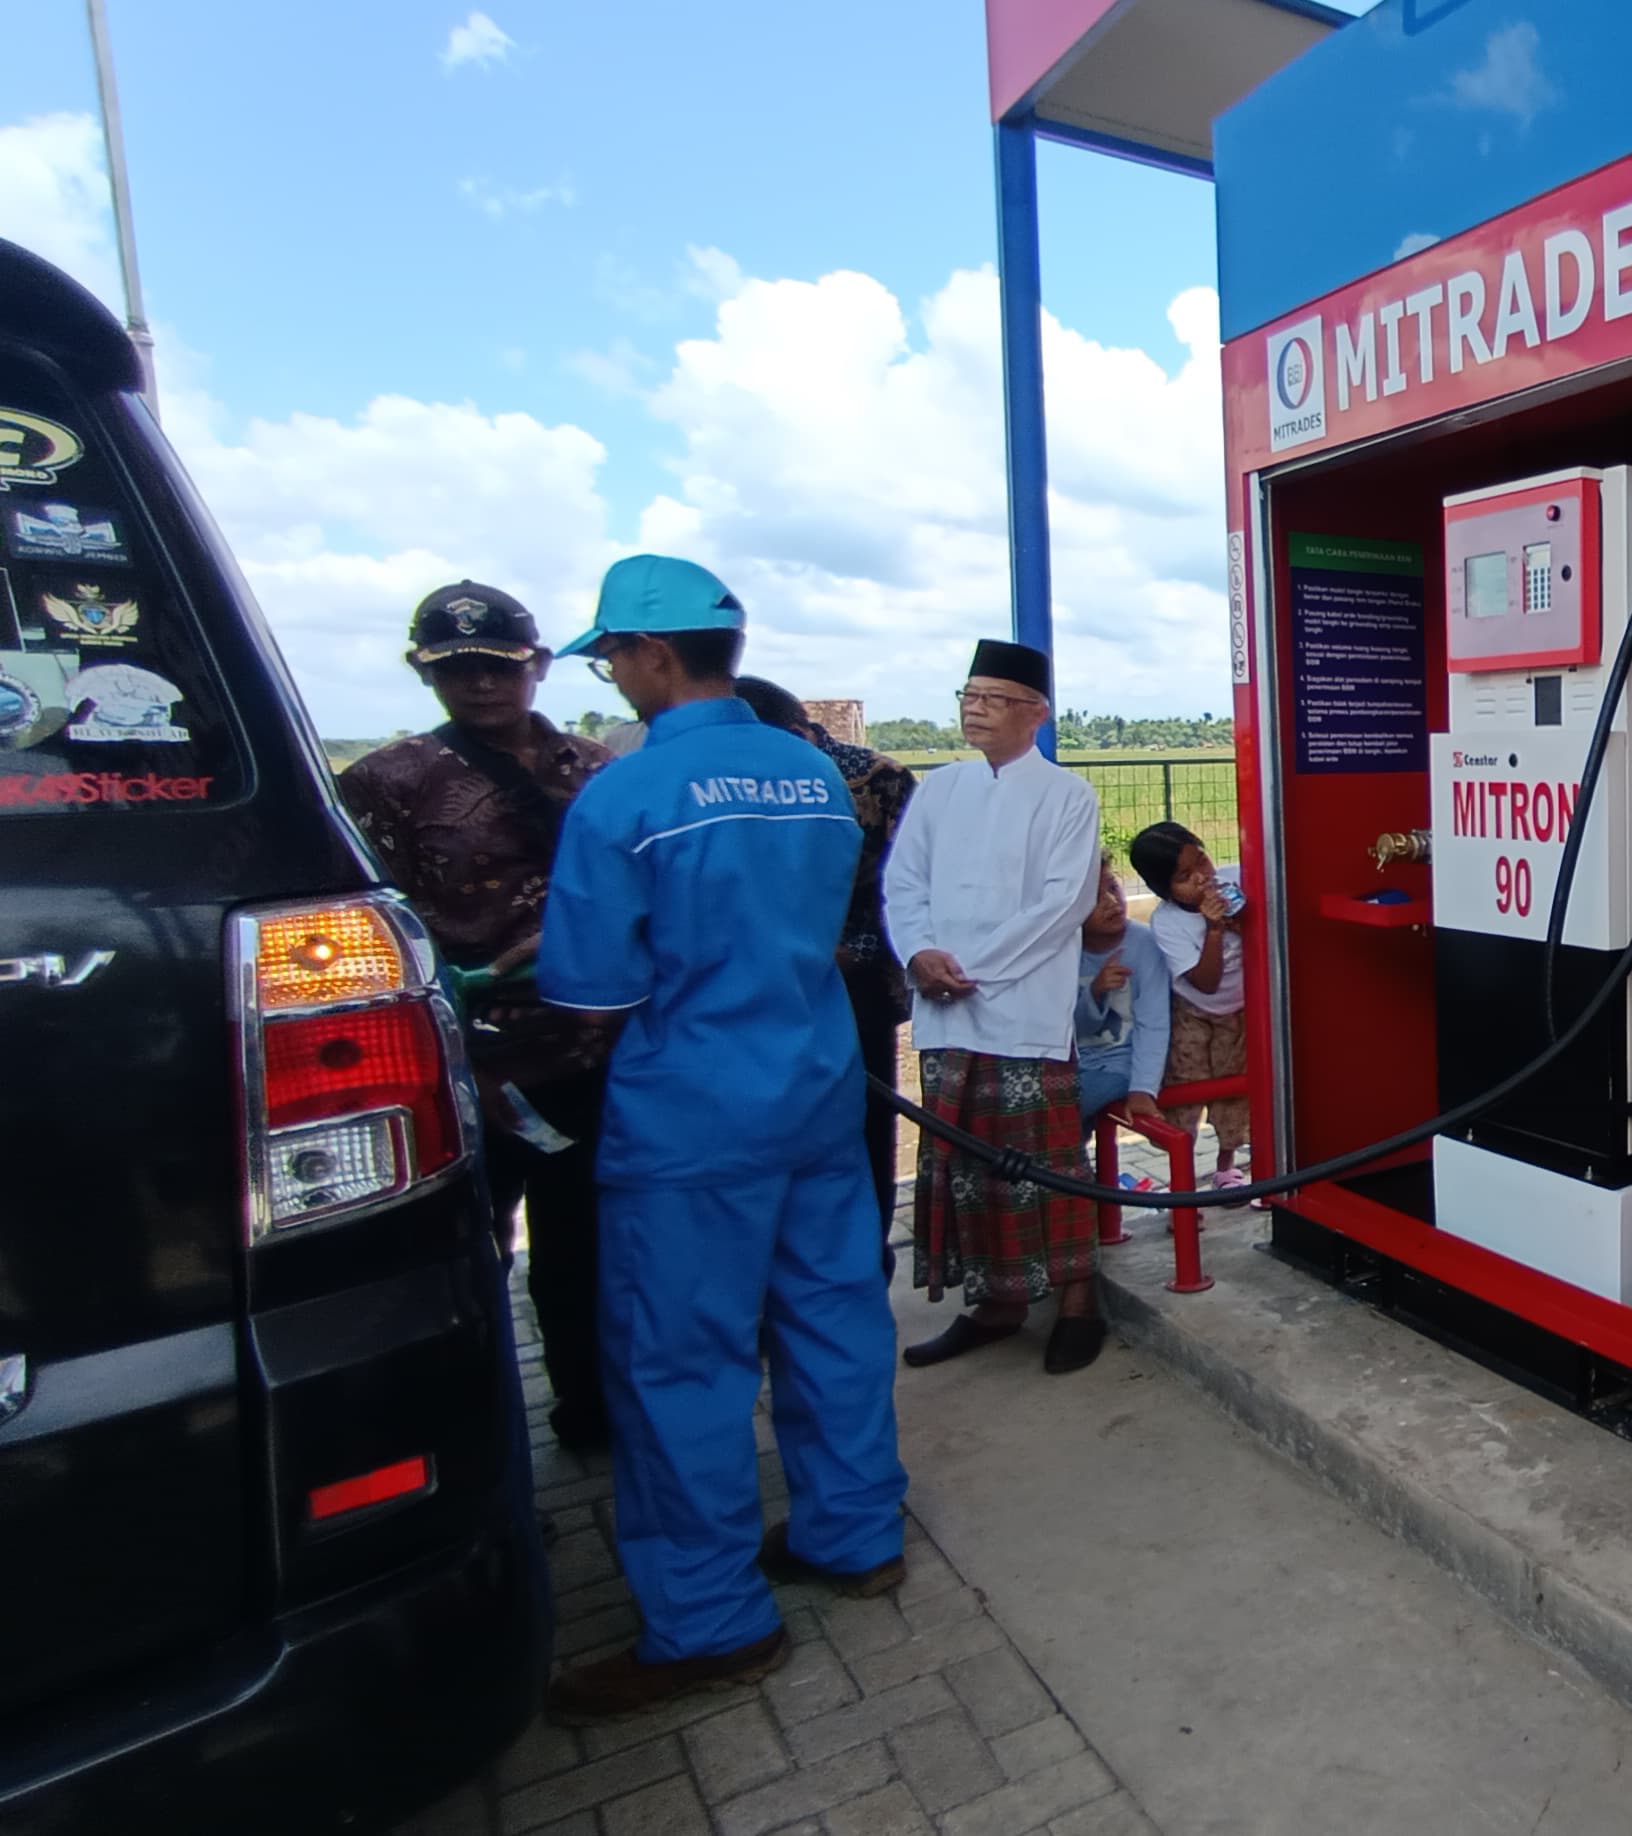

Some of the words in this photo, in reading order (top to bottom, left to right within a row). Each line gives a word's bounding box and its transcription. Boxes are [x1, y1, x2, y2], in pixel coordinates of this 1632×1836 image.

[1273, 412, 1322, 441] MITRADES
[688, 777, 829, 807] MITRADES
[1452, 781, 1582, 843] MITRON
[1495, 855, 1532, 918] 90
